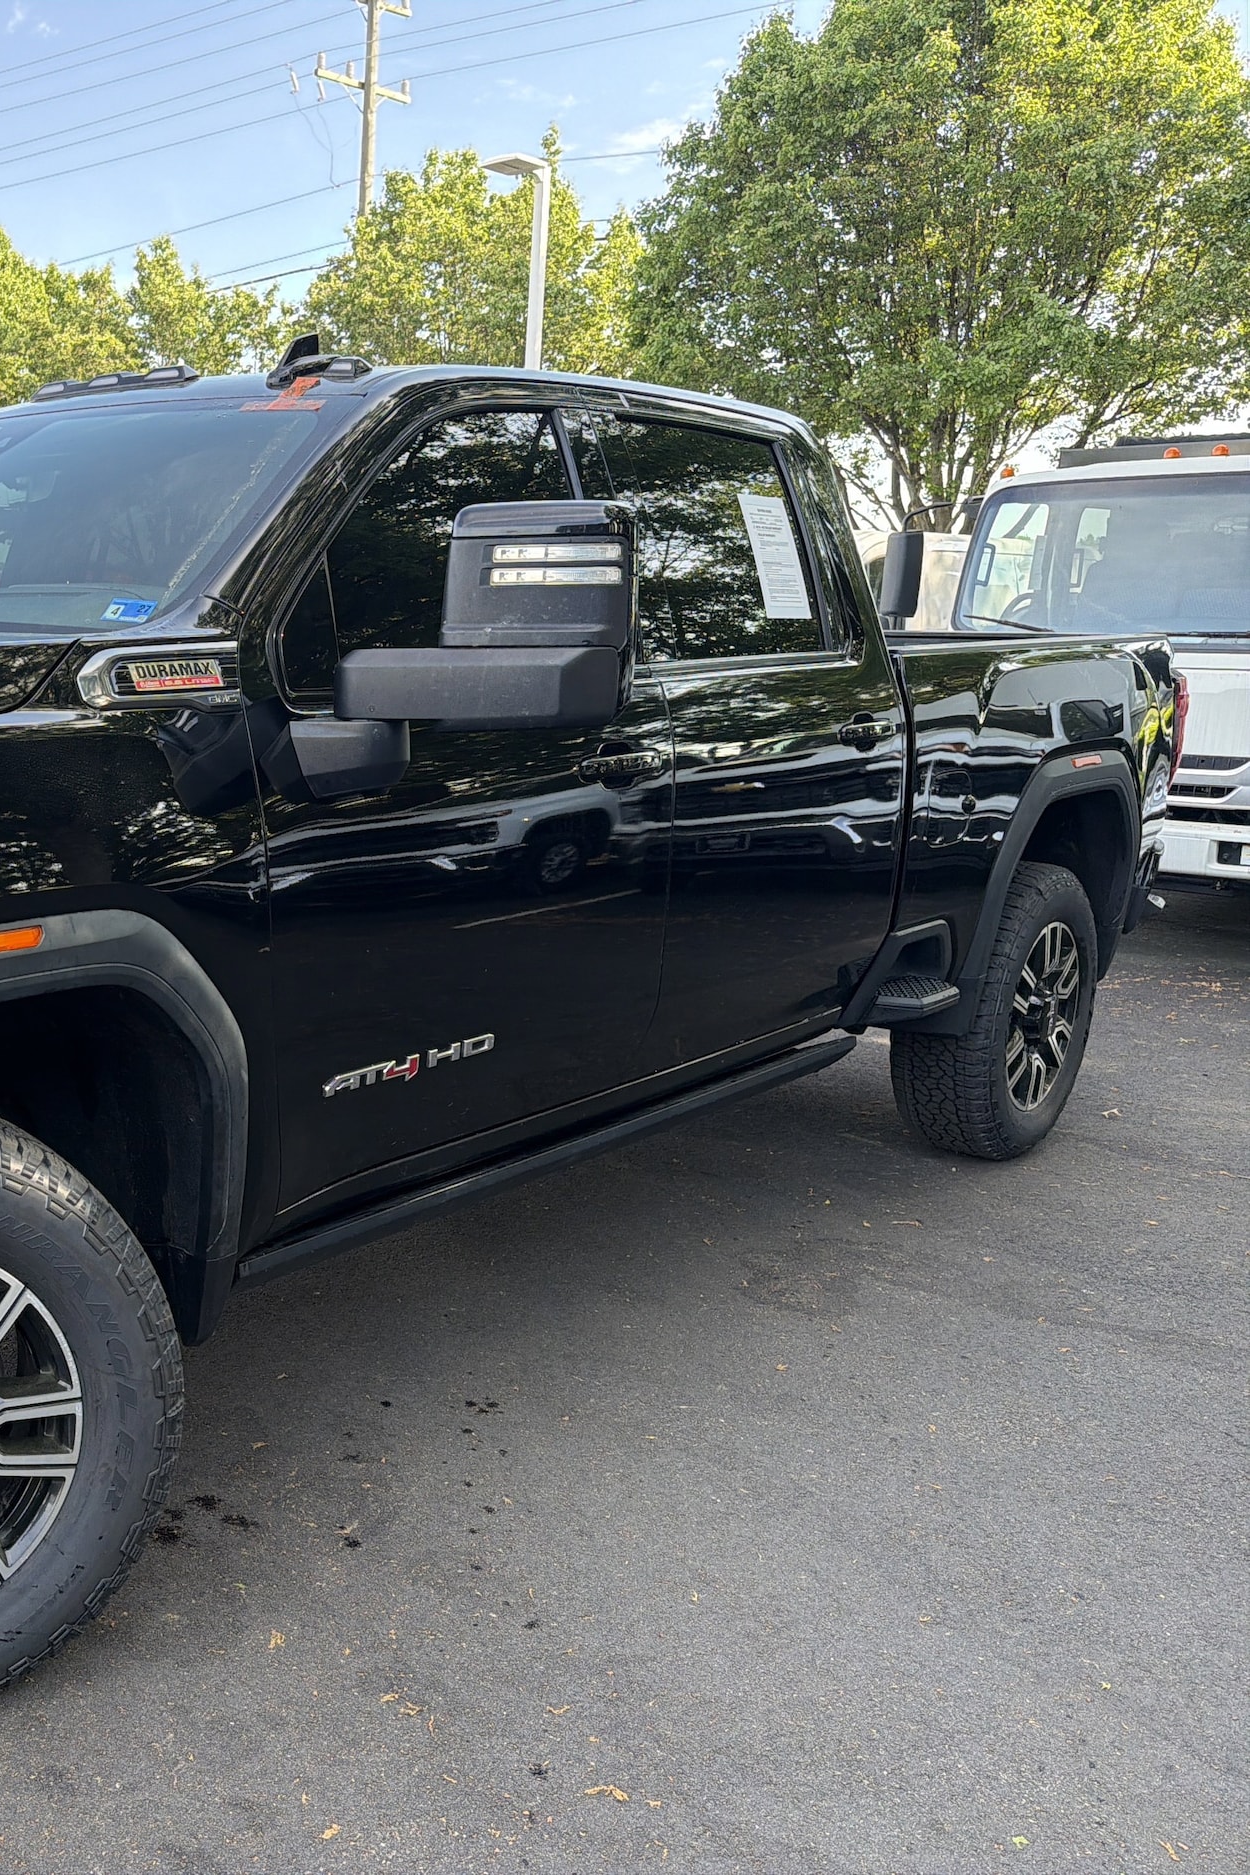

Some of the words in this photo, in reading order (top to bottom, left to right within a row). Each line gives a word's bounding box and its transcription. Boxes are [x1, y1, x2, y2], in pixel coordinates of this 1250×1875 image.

[111, 607, 120, 616] 4
[137, 604, 151, 613] 27
[135, 662, 212, 679] DURAMAX
[209, 694, 238, 704] GMC
[322, 1054, 420, 1098] AT4
[427, 1033, 495, 1068] HD
